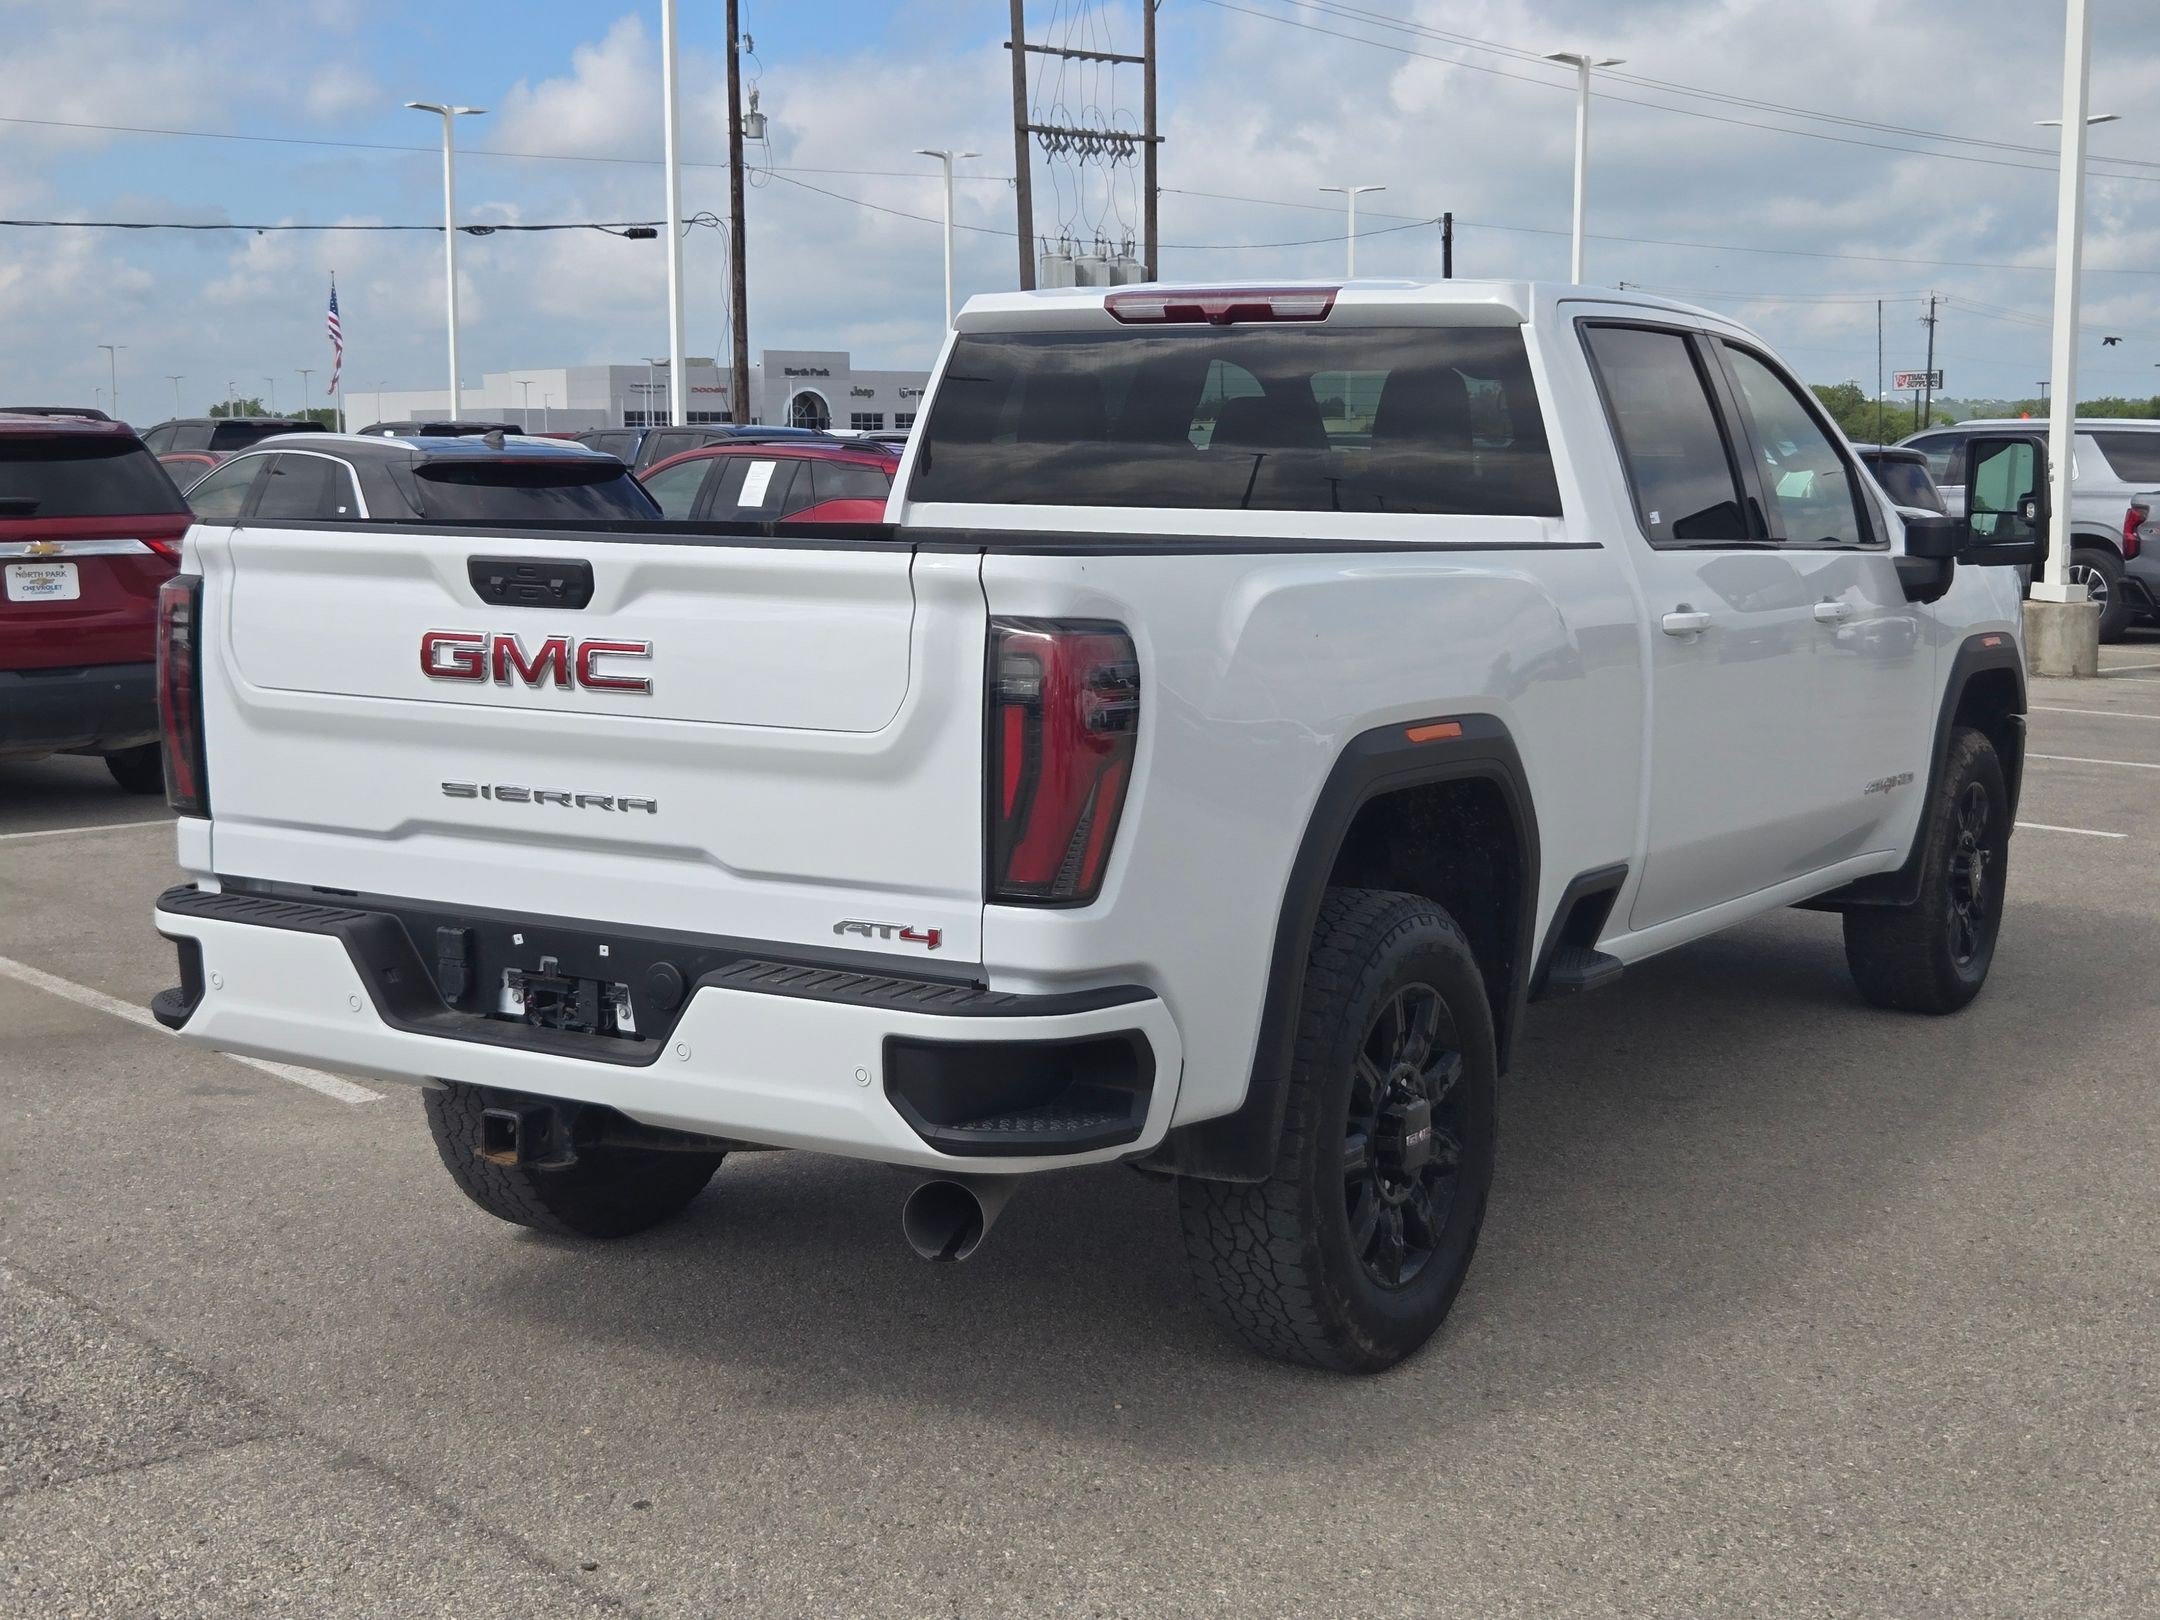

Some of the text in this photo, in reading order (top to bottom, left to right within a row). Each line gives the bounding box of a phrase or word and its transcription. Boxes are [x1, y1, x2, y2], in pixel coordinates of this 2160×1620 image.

[810, 367, 830, 376] Park
[850, 386, 875, 398] Jeep
[15, 570, 67, 579] NORTH PARK
[22, 584, 63, 592] CHEVROLET
[420, 628, 654, 695] GMC
[441, 781, 658, 814] SIERRA
[833, 919, 942, 950] AT4
